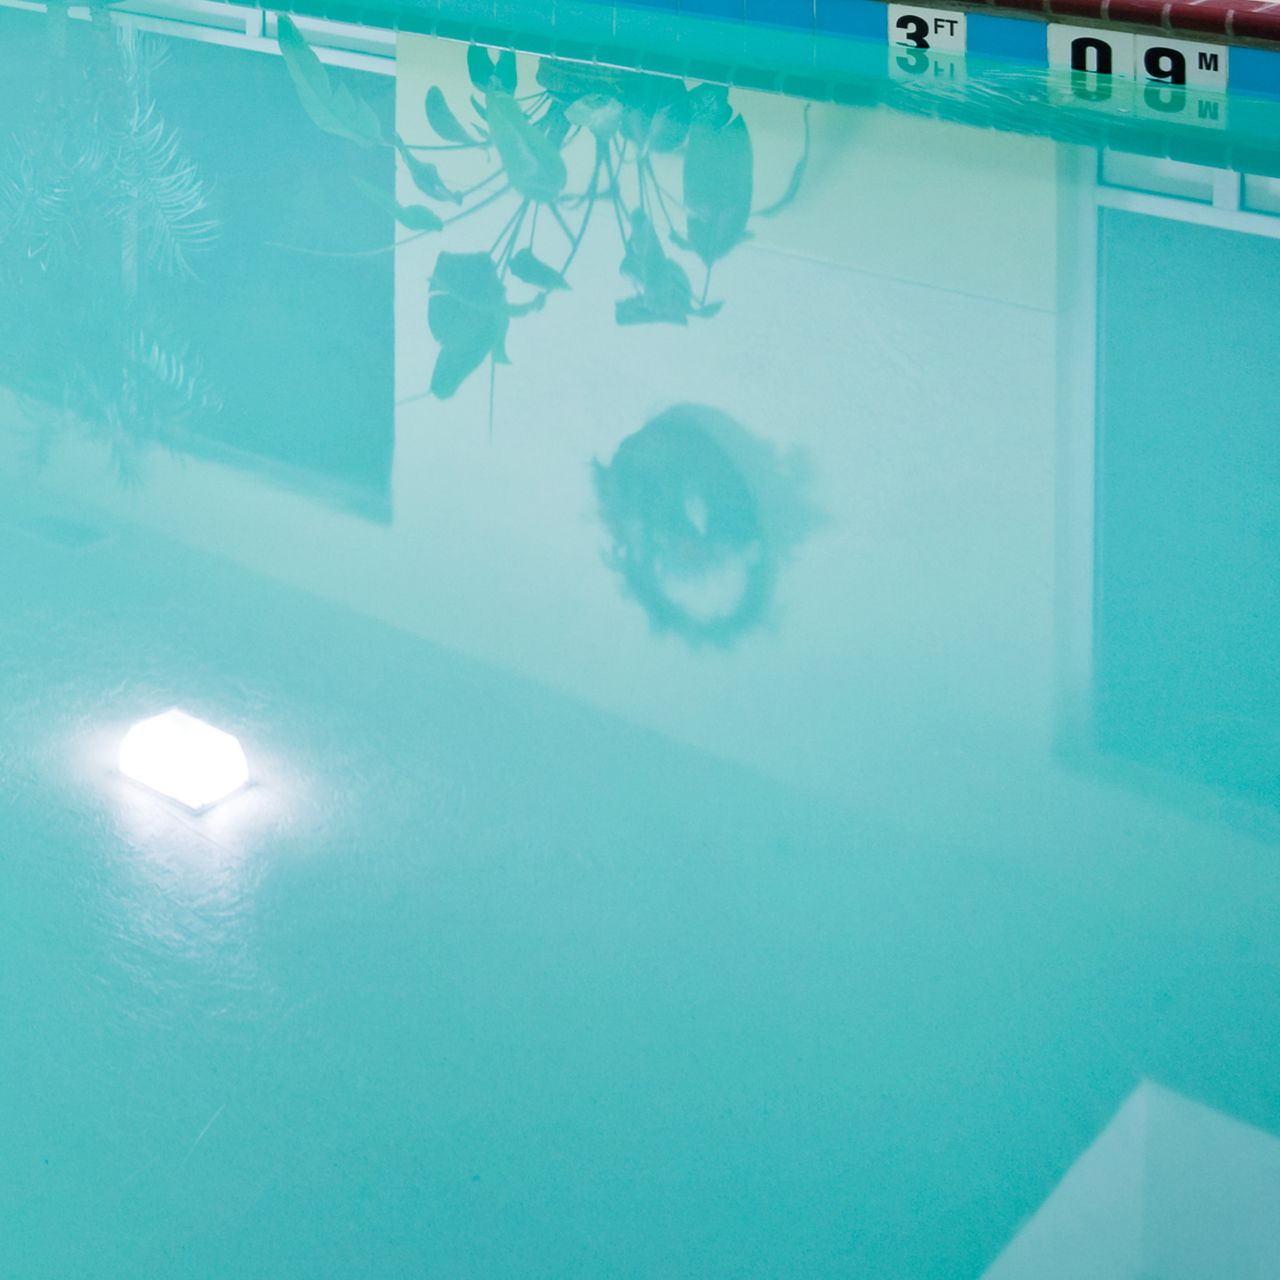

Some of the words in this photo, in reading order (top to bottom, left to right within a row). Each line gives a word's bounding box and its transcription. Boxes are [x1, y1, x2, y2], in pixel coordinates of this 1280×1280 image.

[895, 14, 930, 49] 3
[933, 18, 959, 37] FT
[1198, 51, 1219, 71] M
